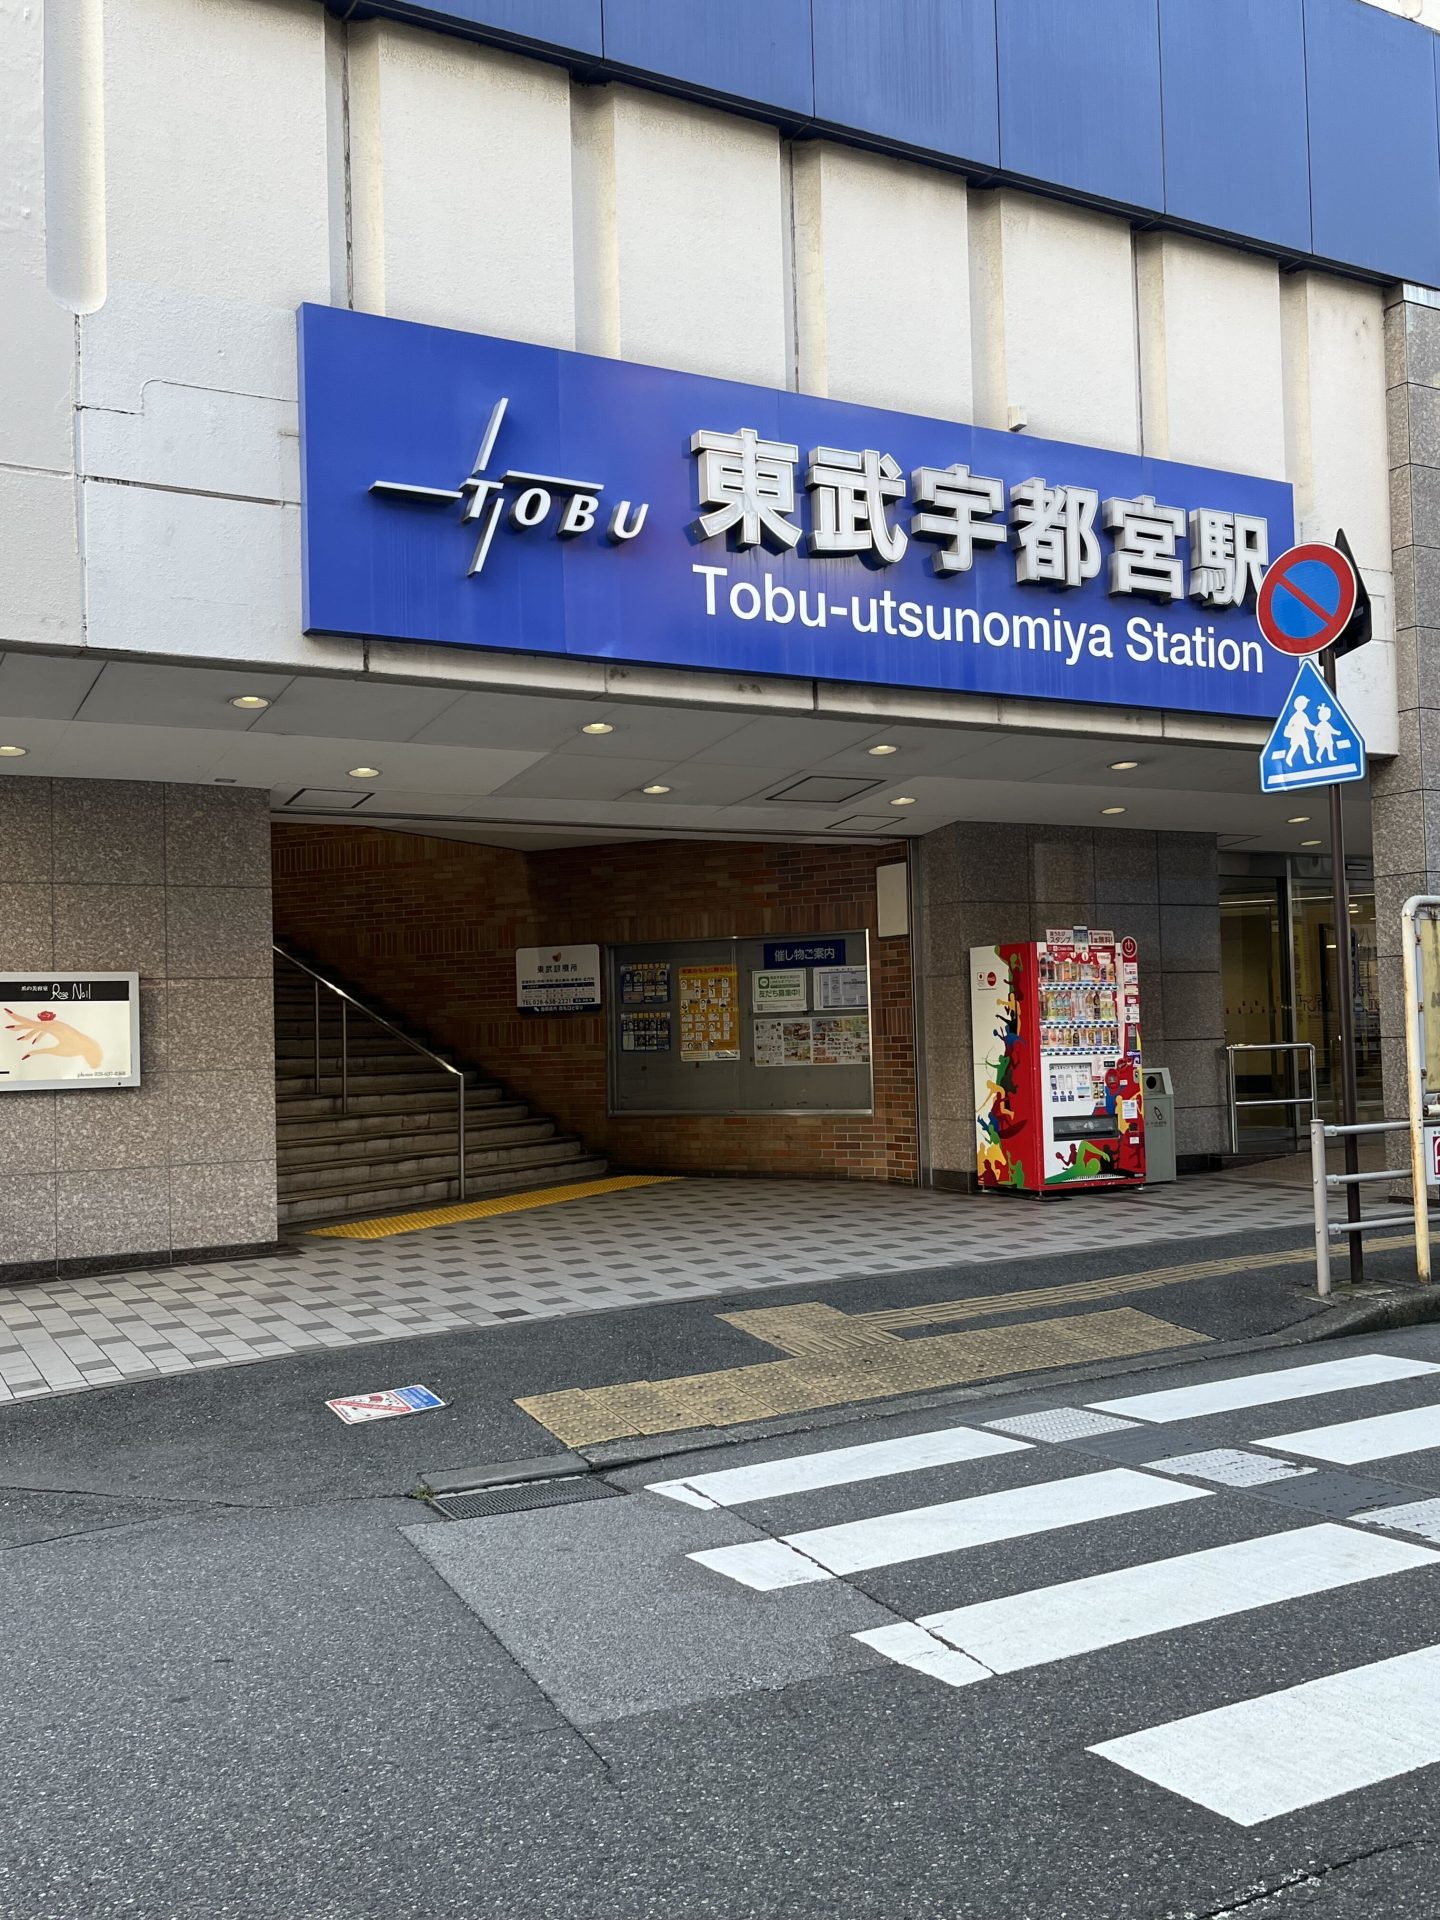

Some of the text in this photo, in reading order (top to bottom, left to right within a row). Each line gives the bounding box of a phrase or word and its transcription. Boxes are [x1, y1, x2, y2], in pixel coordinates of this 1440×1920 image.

[458, 478, 649, 545] TOBU
[690, 428, 1270, 607] 東武宇都宮駅
[692, 564, 1263, 673] Tobu-utsunomiya Station
[774, 947, 835, 962] 催し物ご案内
[72, 983, 91, 1000] Nail
